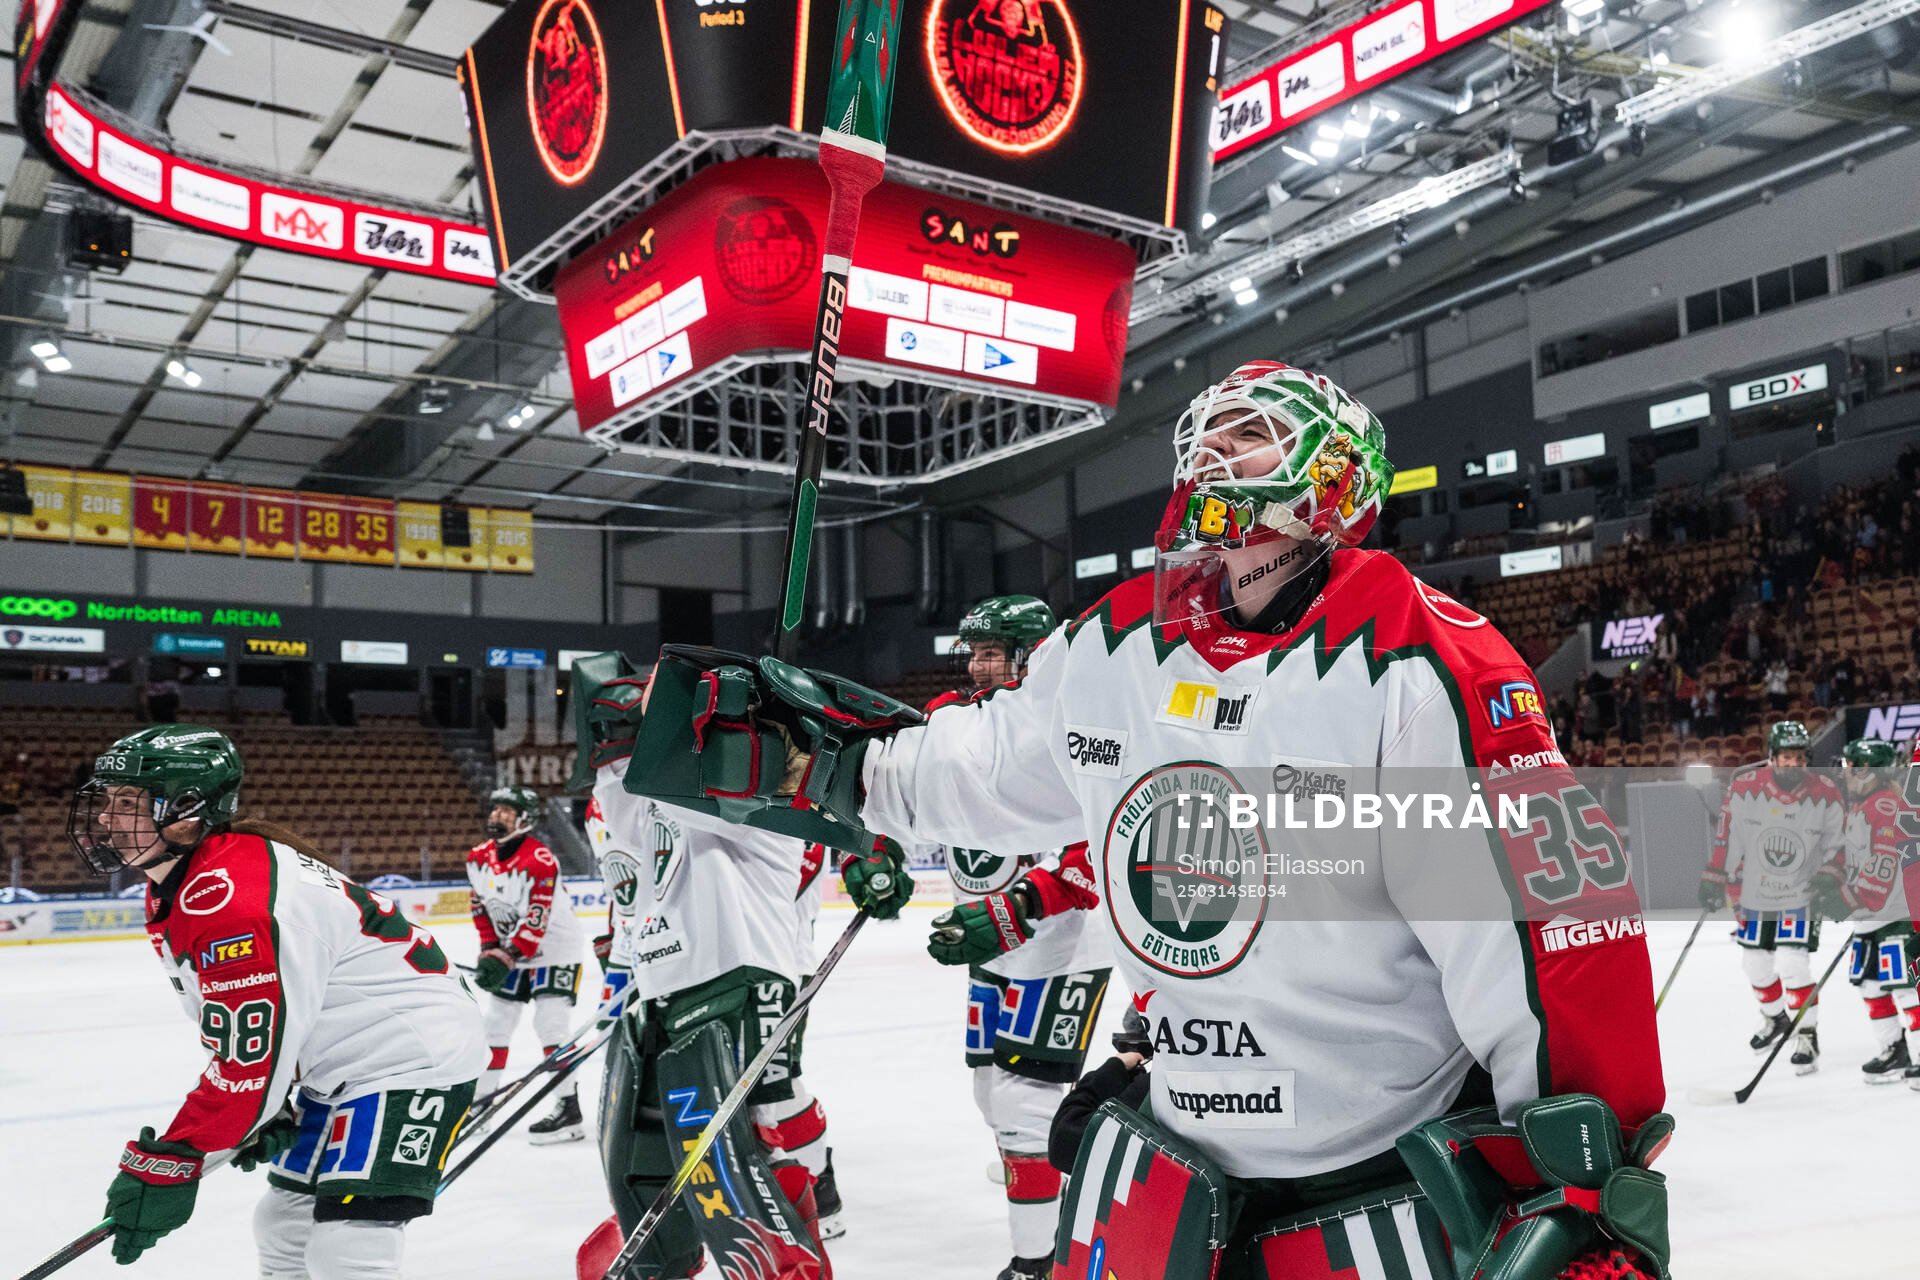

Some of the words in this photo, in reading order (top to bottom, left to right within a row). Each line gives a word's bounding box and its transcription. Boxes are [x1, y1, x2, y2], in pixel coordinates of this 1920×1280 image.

[274, 207, 330, 242] MAX
[925, 213, 1020, 253] SANT
[809, 276, 846, 436] BAUER
[1749, 373, 1807, 401] BDX
[152, 496, 170, 524] 4
[208, 501, 225, 527] 7
[257, 506, 284, 534] 12
[307, 511, 339, 538] 28
[355, 515, 388, 542] 35
[1238, 545, 1303, 590] BAUER
[0, 596, 77, 621] coop
[87, 602, 203, 624] Norrbotten
[211, 608, 282, 628] ARENA
[1601, 613, 1665, 649] NEX
[247, 639, 307, 656] TITAN
[1081, 749, 1119, 767] greven
[1088, 736, 1121, 755] Kaffe
[1303, 770, 1347, 791] Kaffe
[1116, 773, 1183, 839] FRÖLUNDA
[1189, 772, 1235, 806] HOCKE
[1507, 784, 1632, 905] 35
[185, 882, 227, 904] VOLVO
[989, 894, 1022, 950] BAUE
[1141, 931, 1220, 968] GÖTEBORG
[211, 971, 277, 994] Ramudden
[201, 998, 275, 1067] 98
[1579, 1123, 1590, 1147] FHC
[119, 1149, 196, 1178] AUER
[1583, 1148, 1593, 1171] DAM
